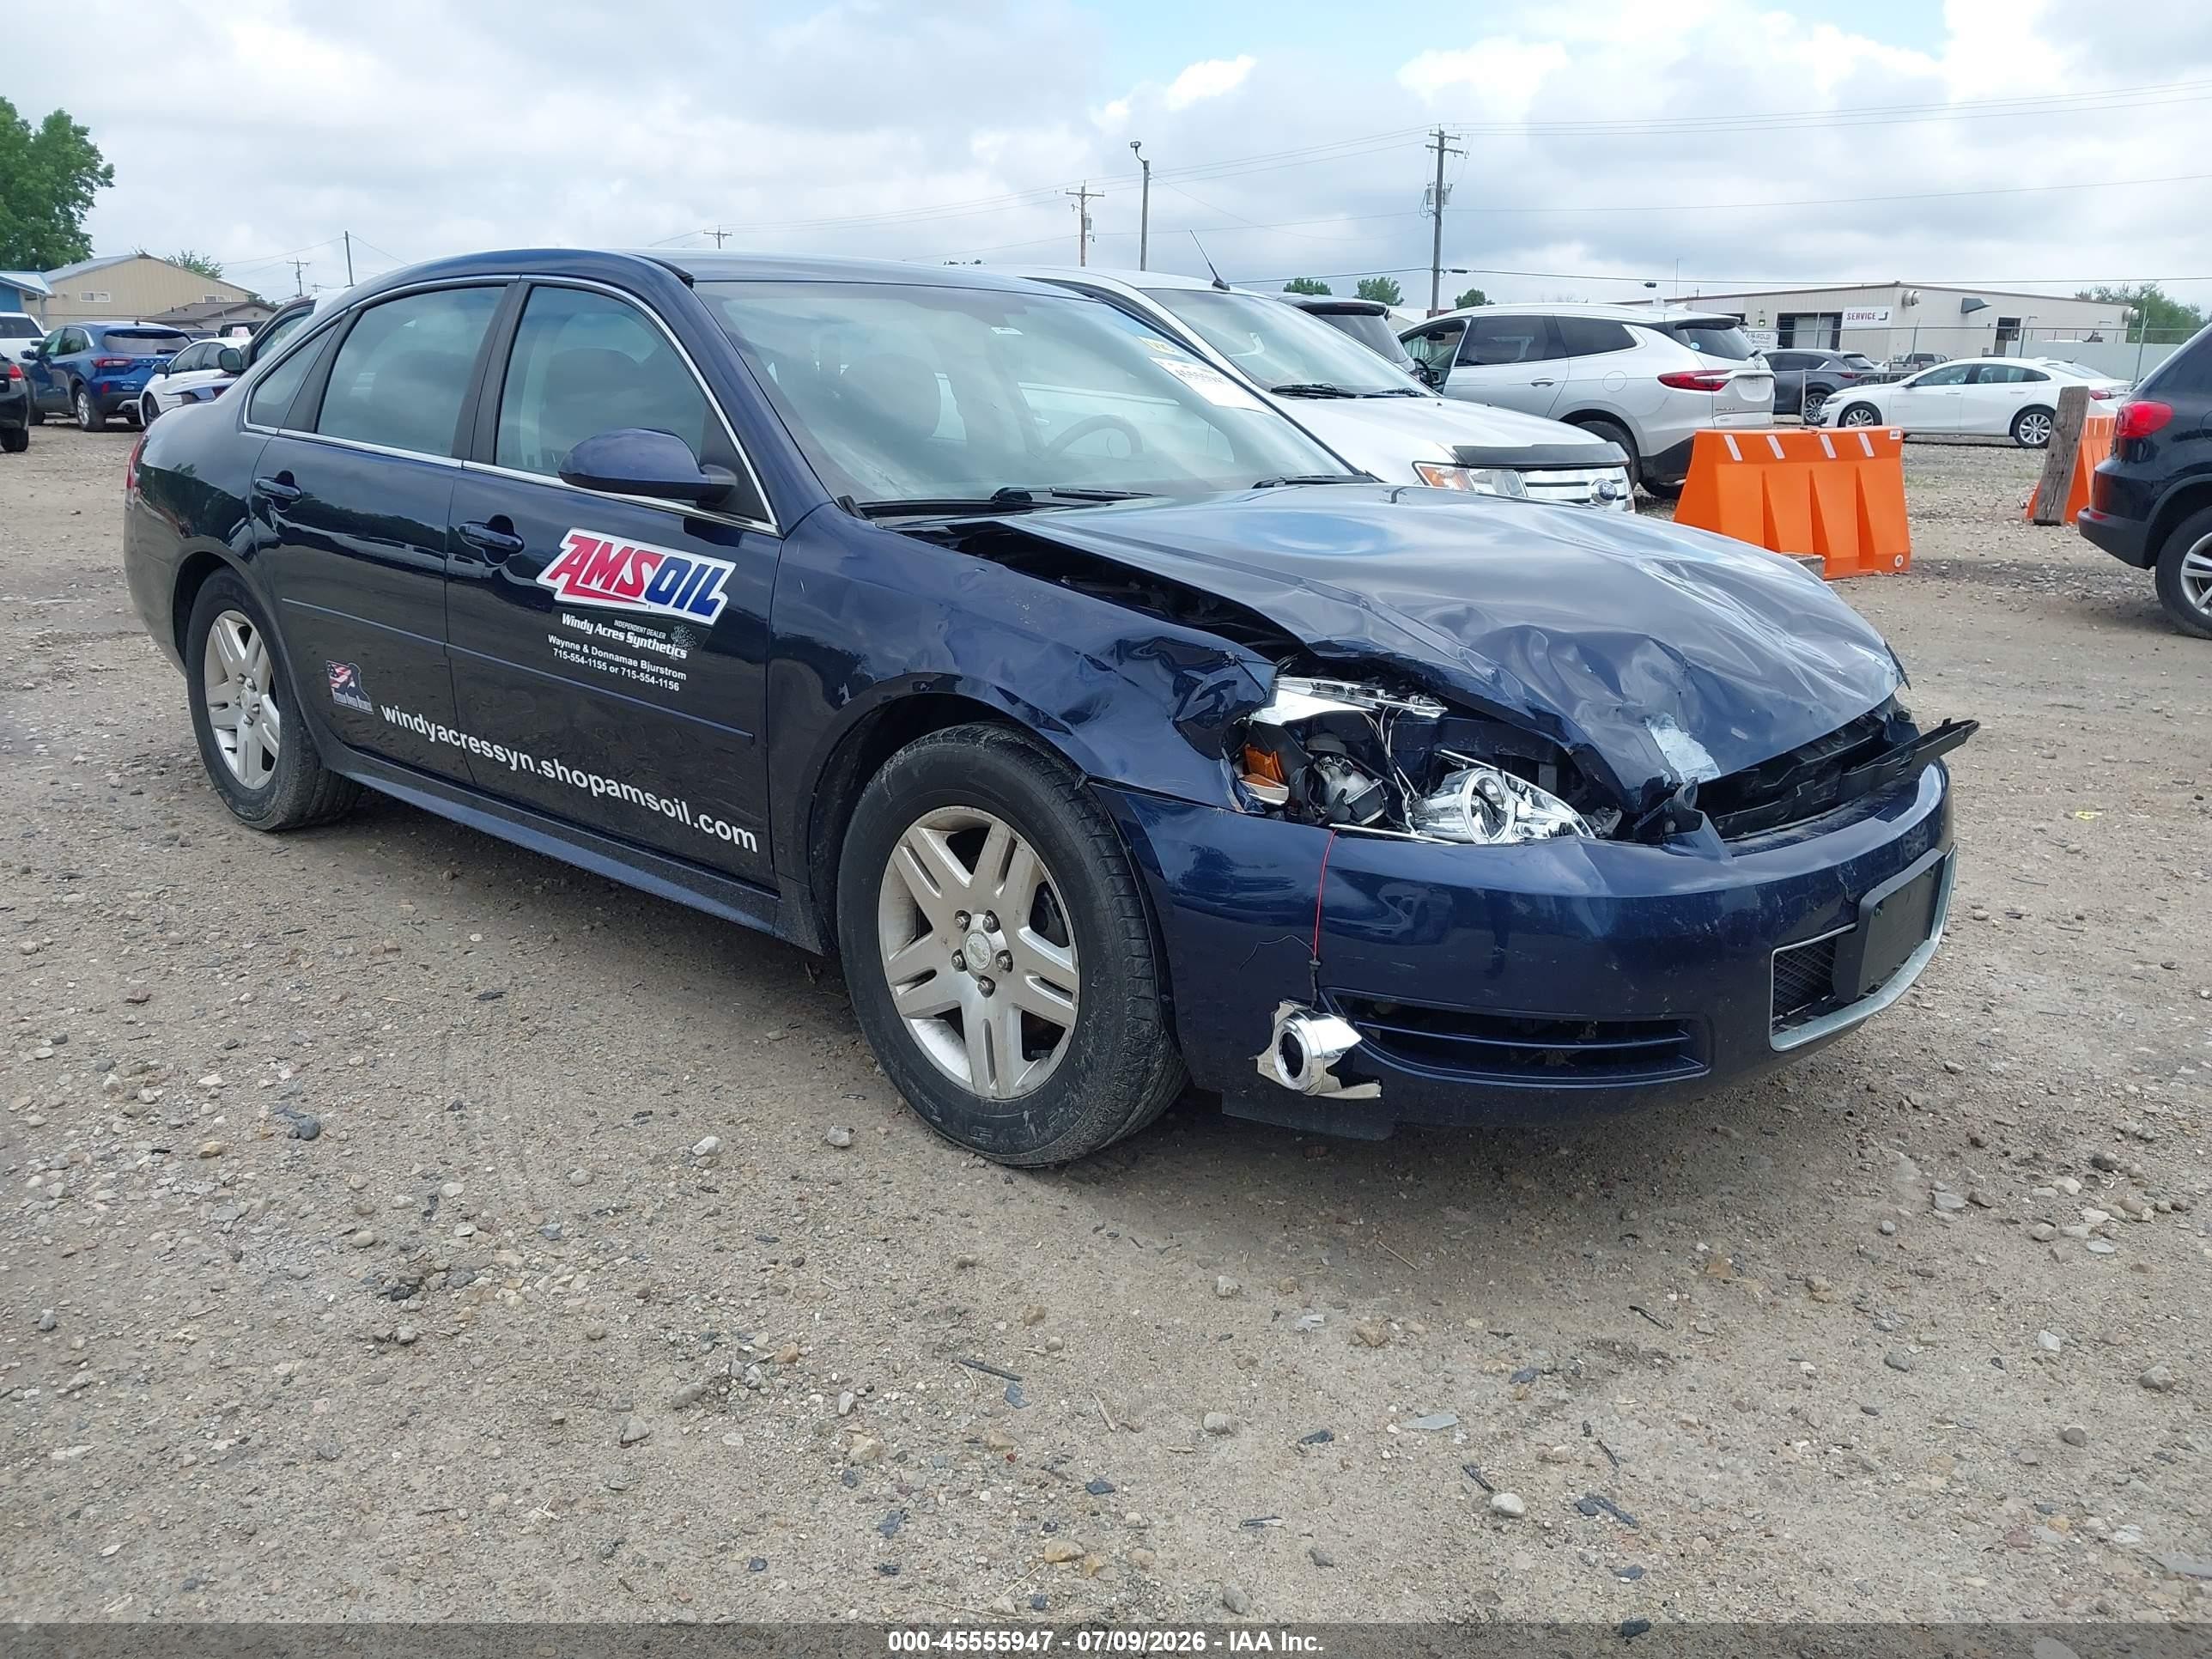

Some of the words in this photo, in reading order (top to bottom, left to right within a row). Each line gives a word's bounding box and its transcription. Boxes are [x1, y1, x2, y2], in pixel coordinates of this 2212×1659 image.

[1846, 312, 1876, 320] SERVICE
[547, 534, 727, 617] AMSOIL
[562, 612, 593, 635] Windy
[593, 623, 625, 641] Acres
[625, 631, 688, 659] Synthetics
[613, 619, 647, 634] INDEPENDENT
[646, 628, 666, 640] DEALER
[548, 634, 580, 651] Waynne
[582, 643, 589, 653] &
[591, 646, 638, 667] Donnamae
[640, 659, 687, 680] Bjurstrom
[553, 647, 607, 671] 715-554-1155
[609, 665, 619, 674] or
[620, 666, 680, 691] 715-554-1156
[380, 704, 757, 853] windyacressyn.shopamsoil.com
